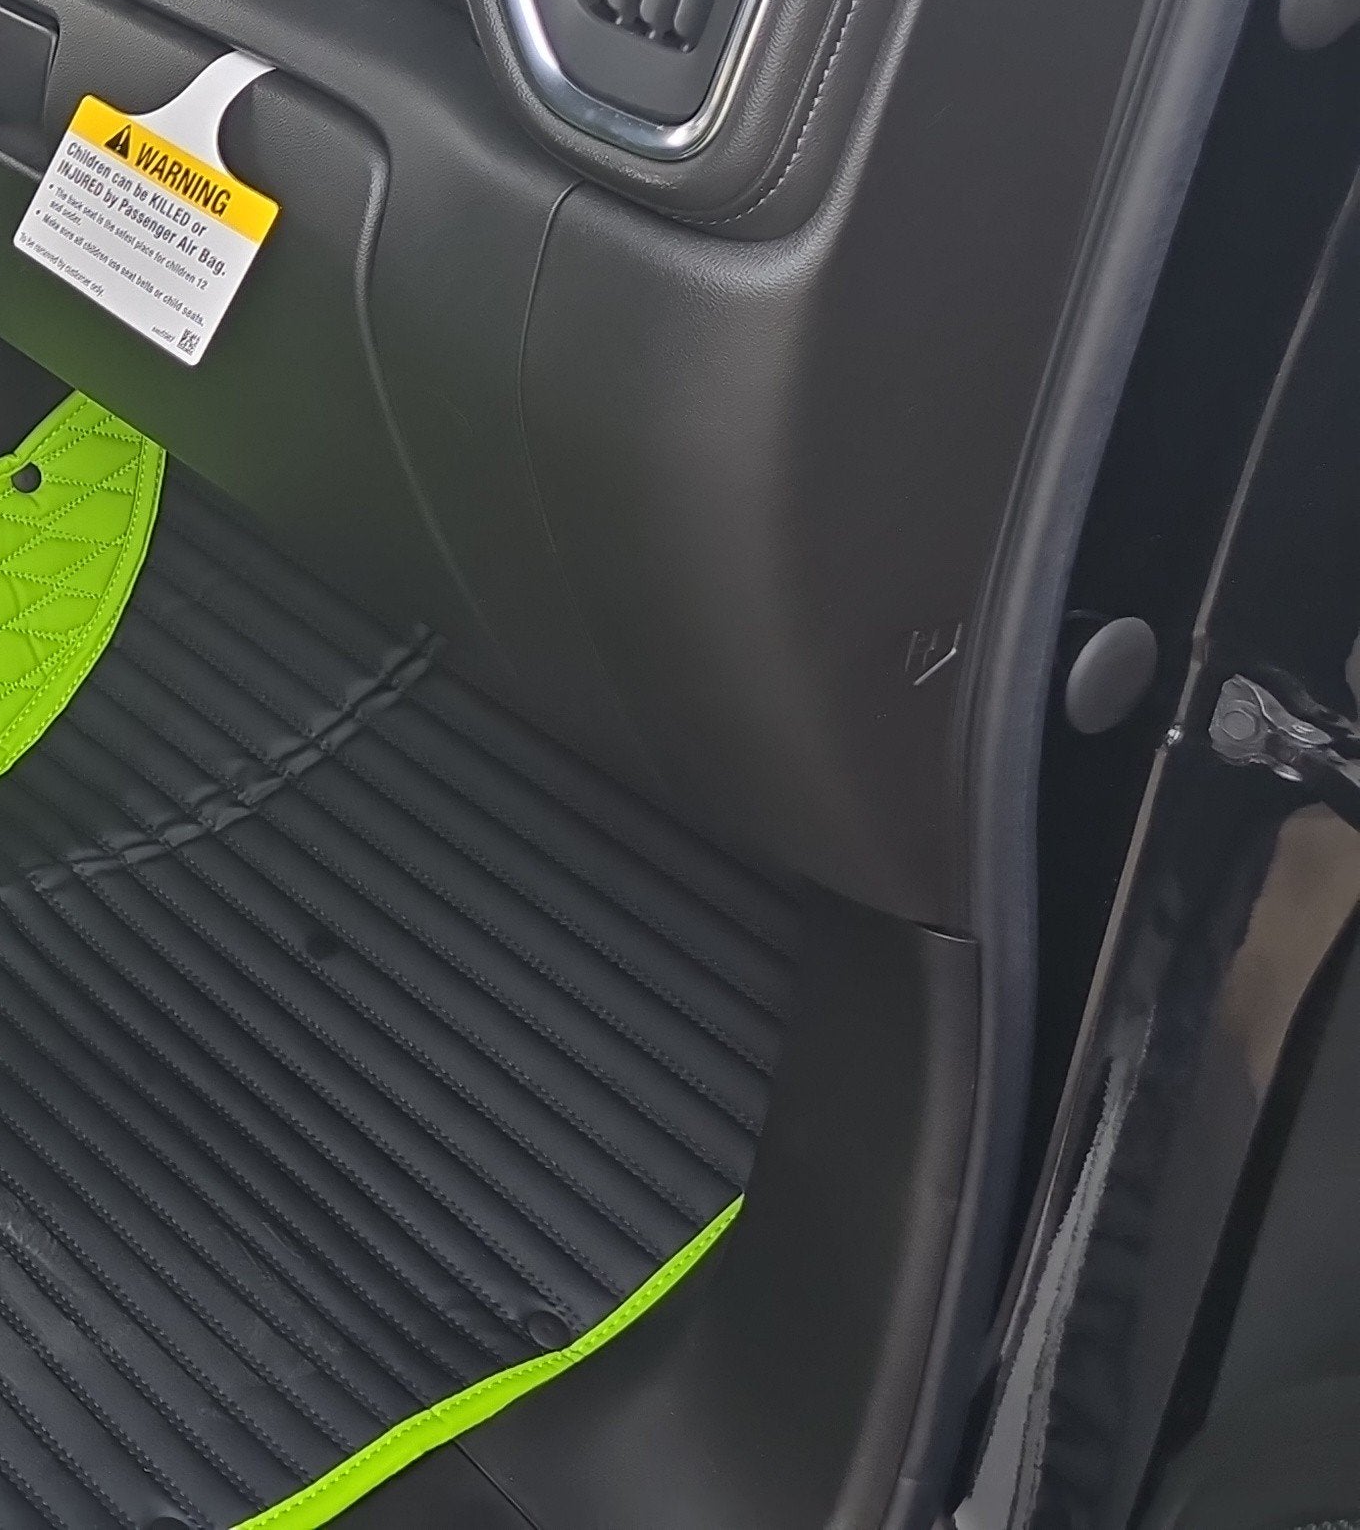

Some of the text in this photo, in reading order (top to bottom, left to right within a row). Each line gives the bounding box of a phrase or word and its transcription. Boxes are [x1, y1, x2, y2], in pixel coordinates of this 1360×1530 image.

[56, 159, 226, 277] INJURED by Passenger Air Bag.
[66, 141, 208, 237] Children can be KILLED or
[134, 142, 231, 217] WARNING
[54, 186, 68, 201] The
[81, 206, 99, 221] seat
[95, 213, 105, 225] is
[103, 218, 116, 233] the
[114, 227, 137, 246] safest
[132, 240, 155, 258] place
[153, 251, 167, 265] for
[165, 260, 196, 284] children
[196, 277, 209, 291] 12
[82, 241, 109, 264] children
[120, 266, 137, 283] seat
[135, 274, 155, 294] belts
[153, 289, 164, 300] or
[162, 295, 184, 312] child
[181, 306, 204, 327] seats.
